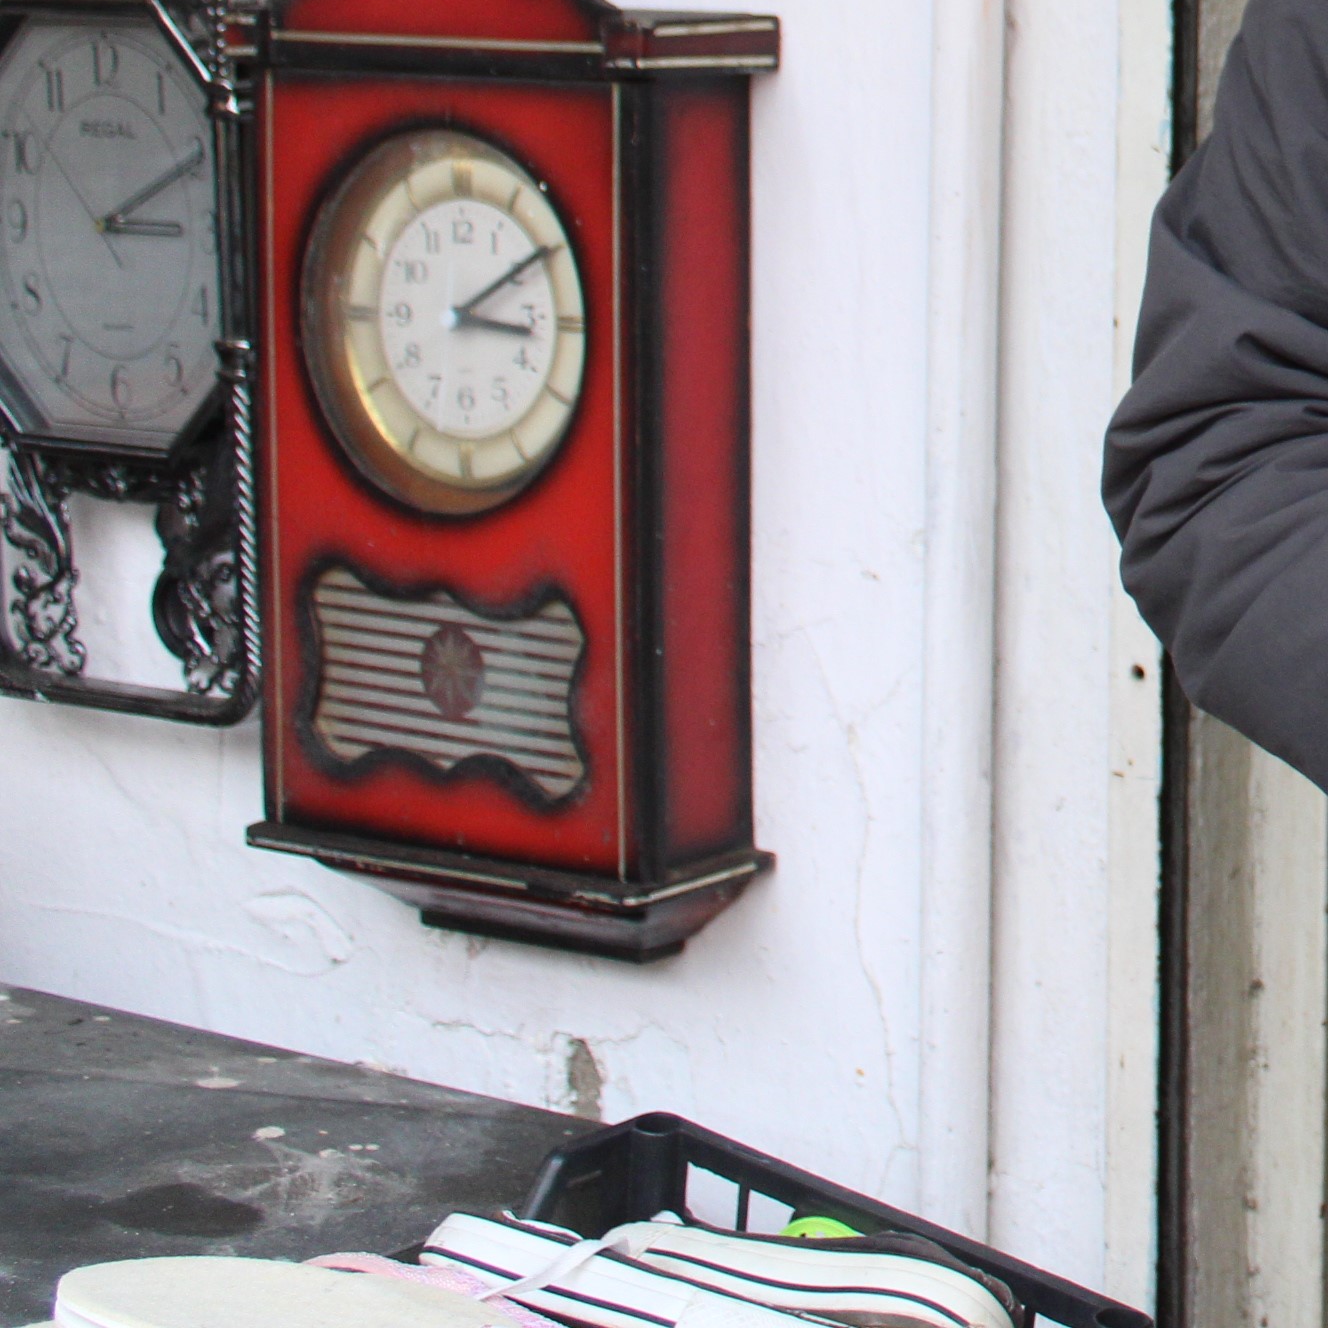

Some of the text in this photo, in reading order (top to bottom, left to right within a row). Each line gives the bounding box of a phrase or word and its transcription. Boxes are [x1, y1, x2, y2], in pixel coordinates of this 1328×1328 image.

[452, 220, 473, 244] 12
[403, 260, 428, 284] 10
[21, 272, 43, 317] 8
[395, 303, 411, 326] 9
[403, 343, 421, 368] 8
[512, 346, 527, 370] 4
[427, 374, 442, 399] 7
[457, 386, 475, 411] 6
[491, 376, 508, 403] 5
